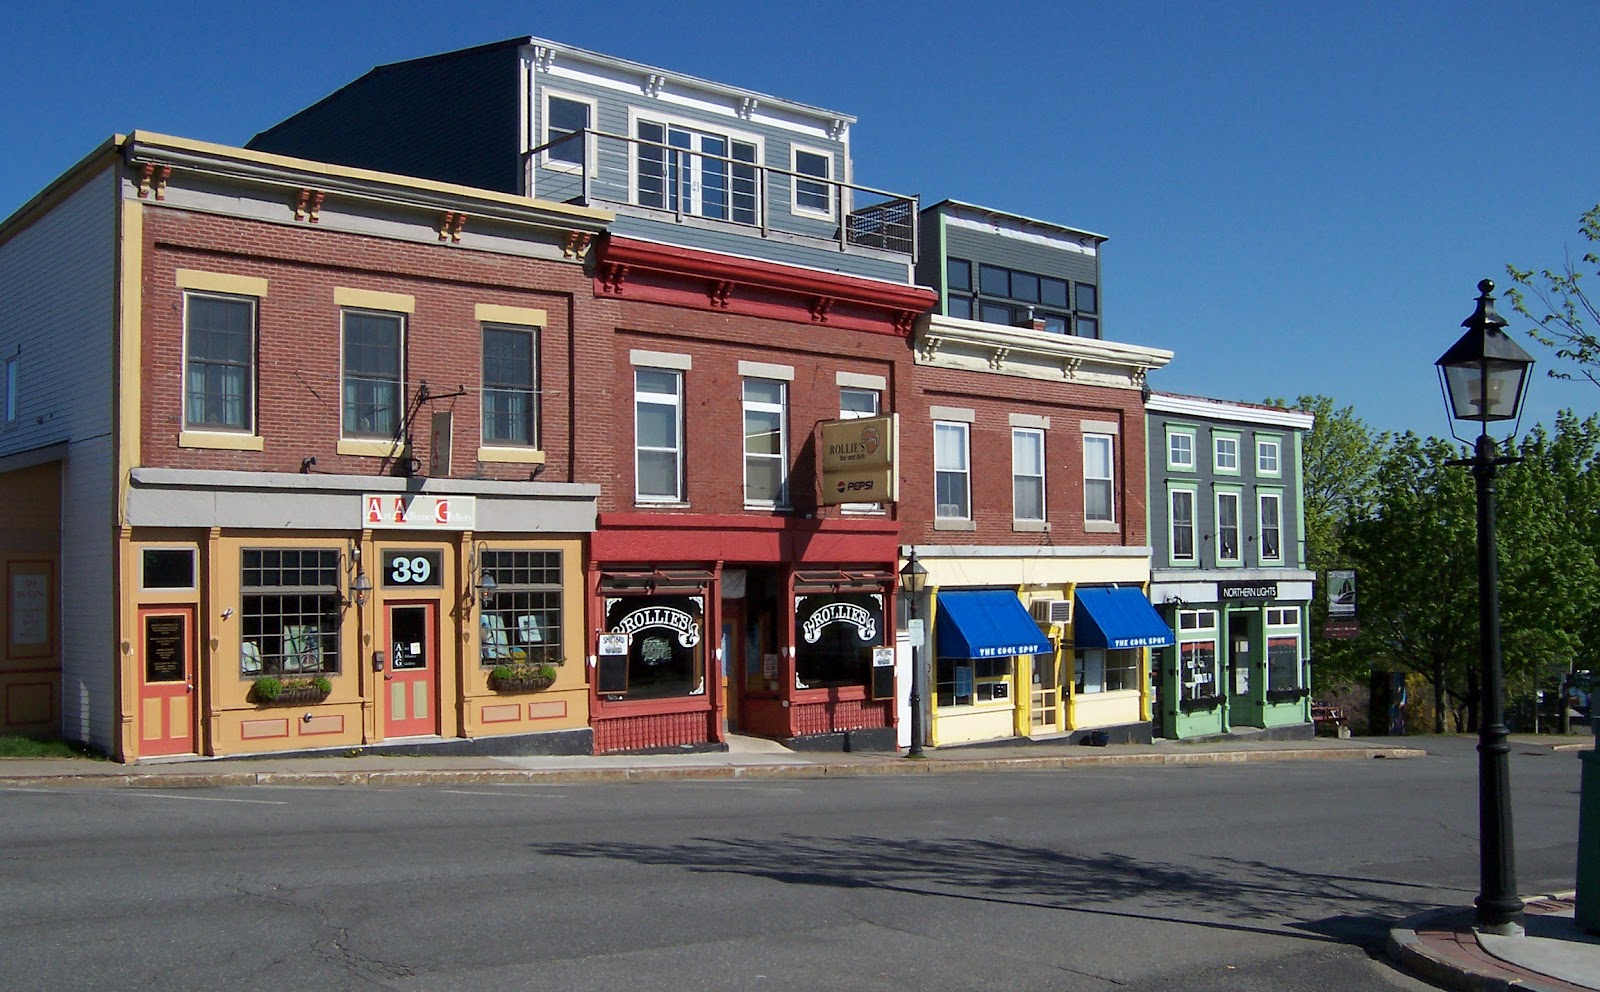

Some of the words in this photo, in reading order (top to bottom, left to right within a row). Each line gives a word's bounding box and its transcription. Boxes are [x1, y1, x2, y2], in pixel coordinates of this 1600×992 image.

[829, 443, 865, 455] ROLLIE'S
[848, 481, 873, 491] PEPSI
[392, 556, 430, 583] 39
[1223, 587, 1256, 598] NORTHERN
[1256, 586, 1276, 597] LIGHTS
[1114, 639, 1128, 647] THE
[1130, 638, 1147, 646] COOL
[1148, 637, 1165, 645] SPOT
[979, 648, 995, 657] THE
[997, 646, 1017, 655] COOL
[1018, 645, 1038, 654] SPOT
